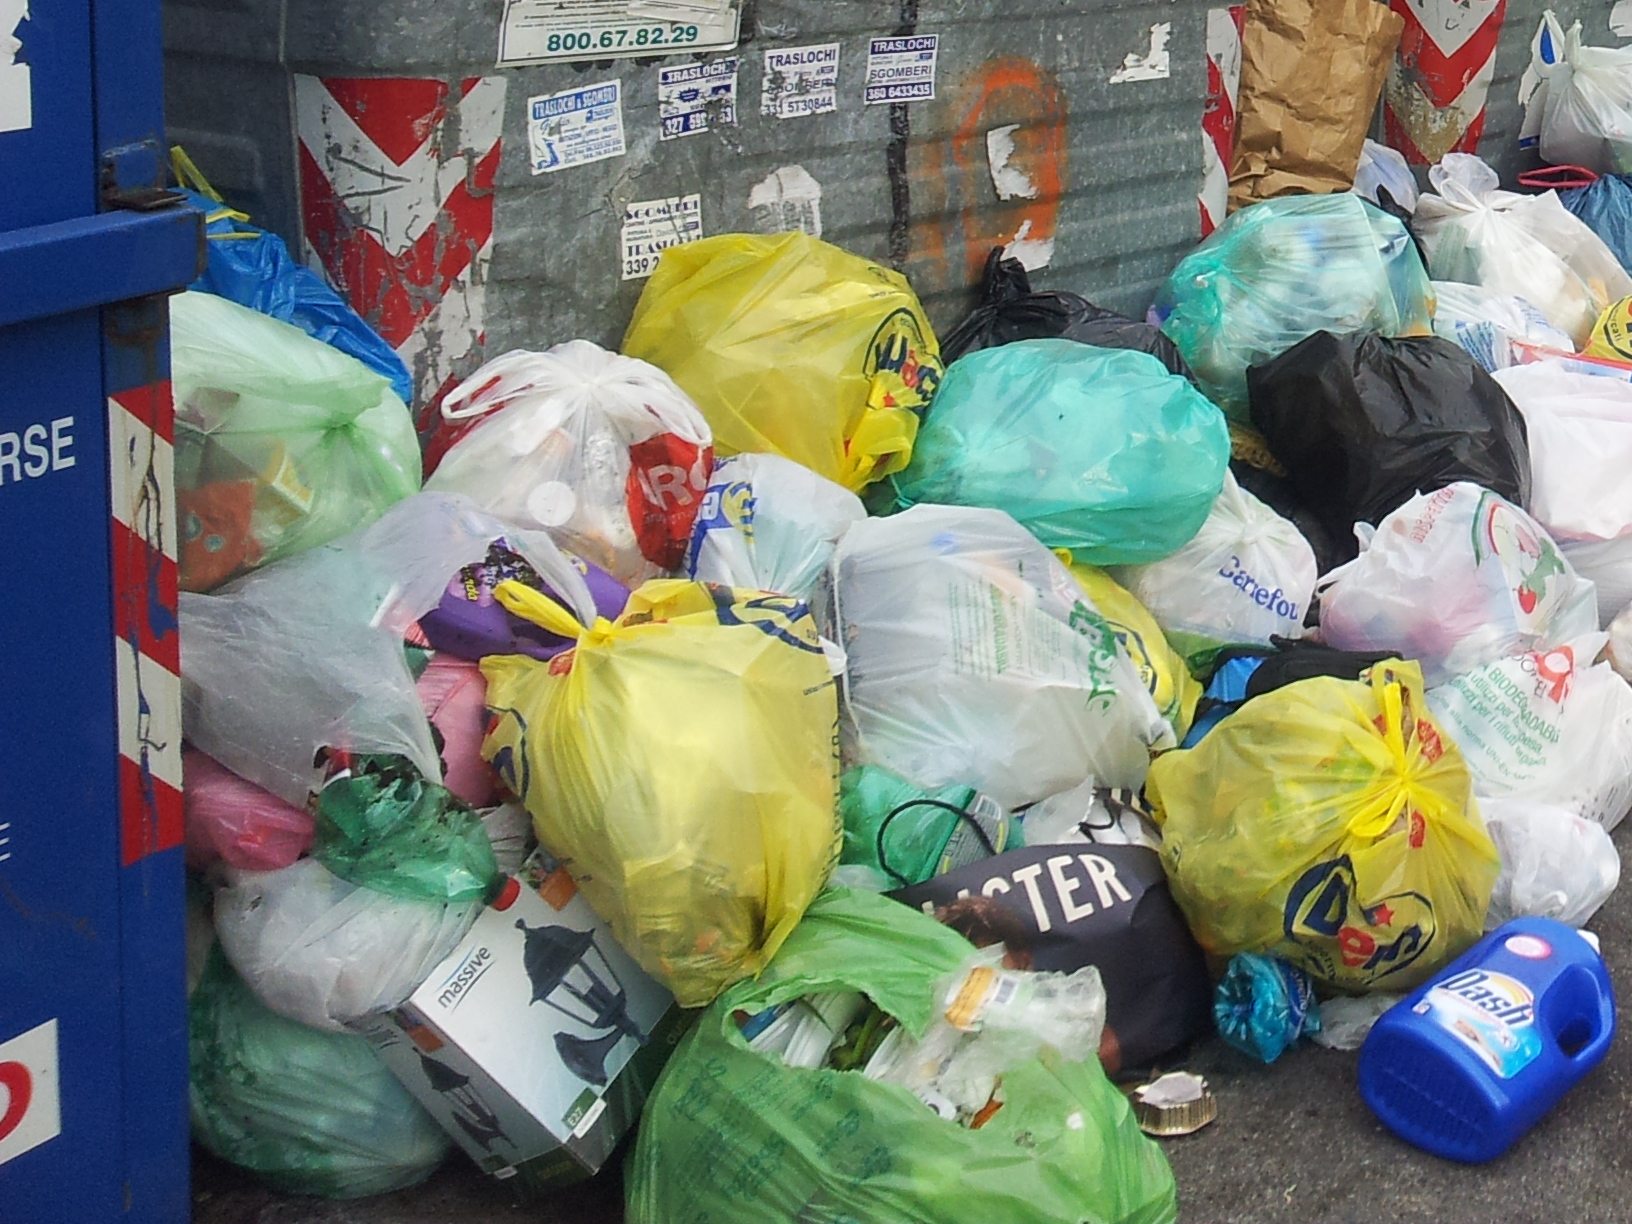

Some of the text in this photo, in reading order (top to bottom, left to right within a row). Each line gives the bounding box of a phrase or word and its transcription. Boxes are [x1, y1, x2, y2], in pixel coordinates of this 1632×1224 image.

[546, 26, 699, 51] 800.67.82.29
[873, 38, 936, 52] TRASLOCHI
[768, 49, 836, 68] TRASLOCHI
[870, 65, 932, 80] SGOMBERI
[535, 95, 576, 118] TRASLOCHI
[626, 257, 649, 275] 339
[437, 945, 491, 1008] massive
[1438, 970, 1533, 1026] Dash
